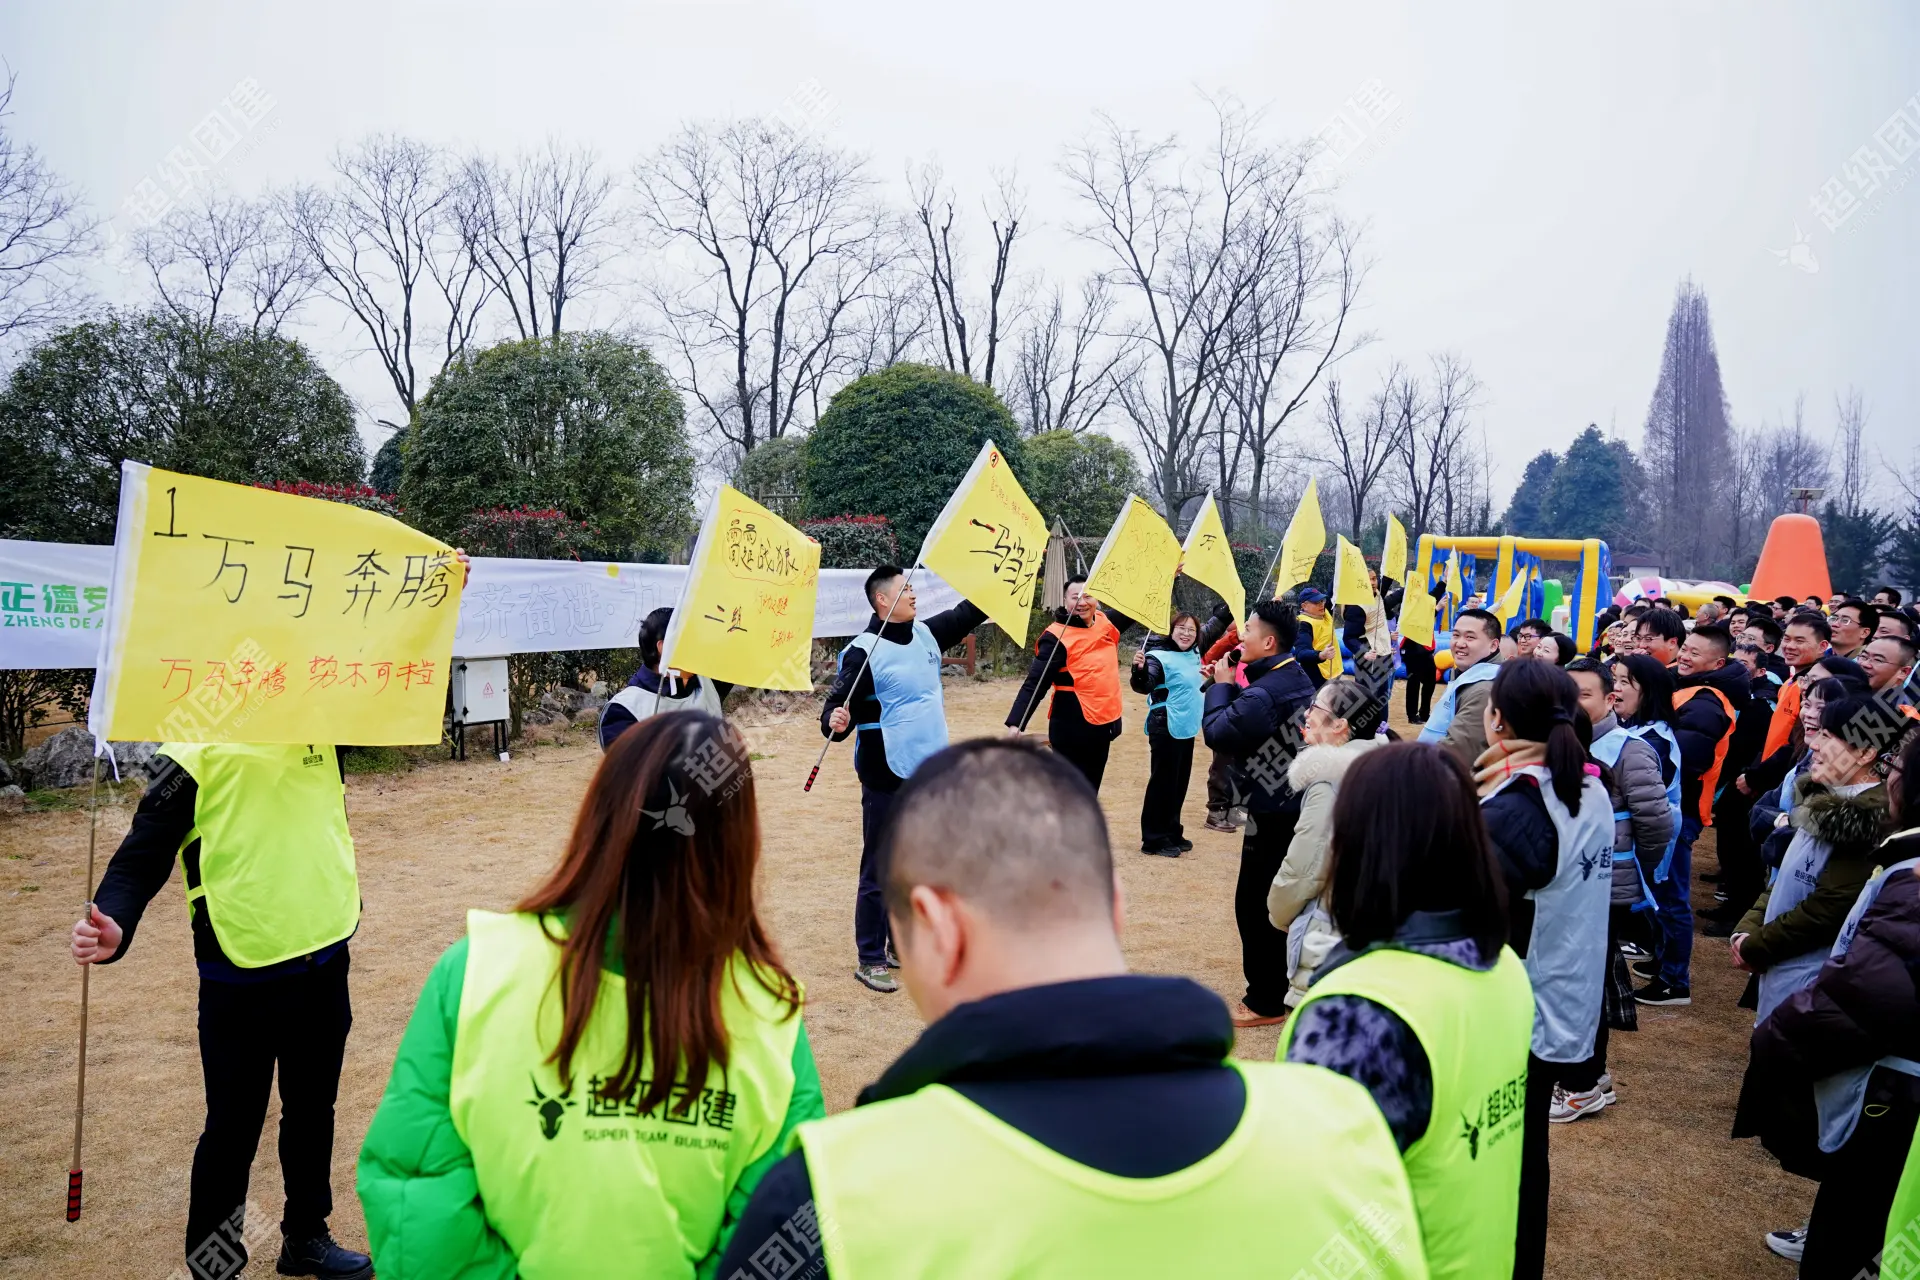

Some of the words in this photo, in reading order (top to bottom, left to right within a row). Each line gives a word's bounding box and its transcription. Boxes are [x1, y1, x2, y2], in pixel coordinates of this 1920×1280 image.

[153, 486, 188, 539] 1
[0, 581, 108, 614] 正德安
[202, 533, 457, 628] 万马奔腾
[4, 614, 66, 629] ZHENG
[69, 616, 92, 629] DE
[160, 657, 288, 709] 万马奔腾
